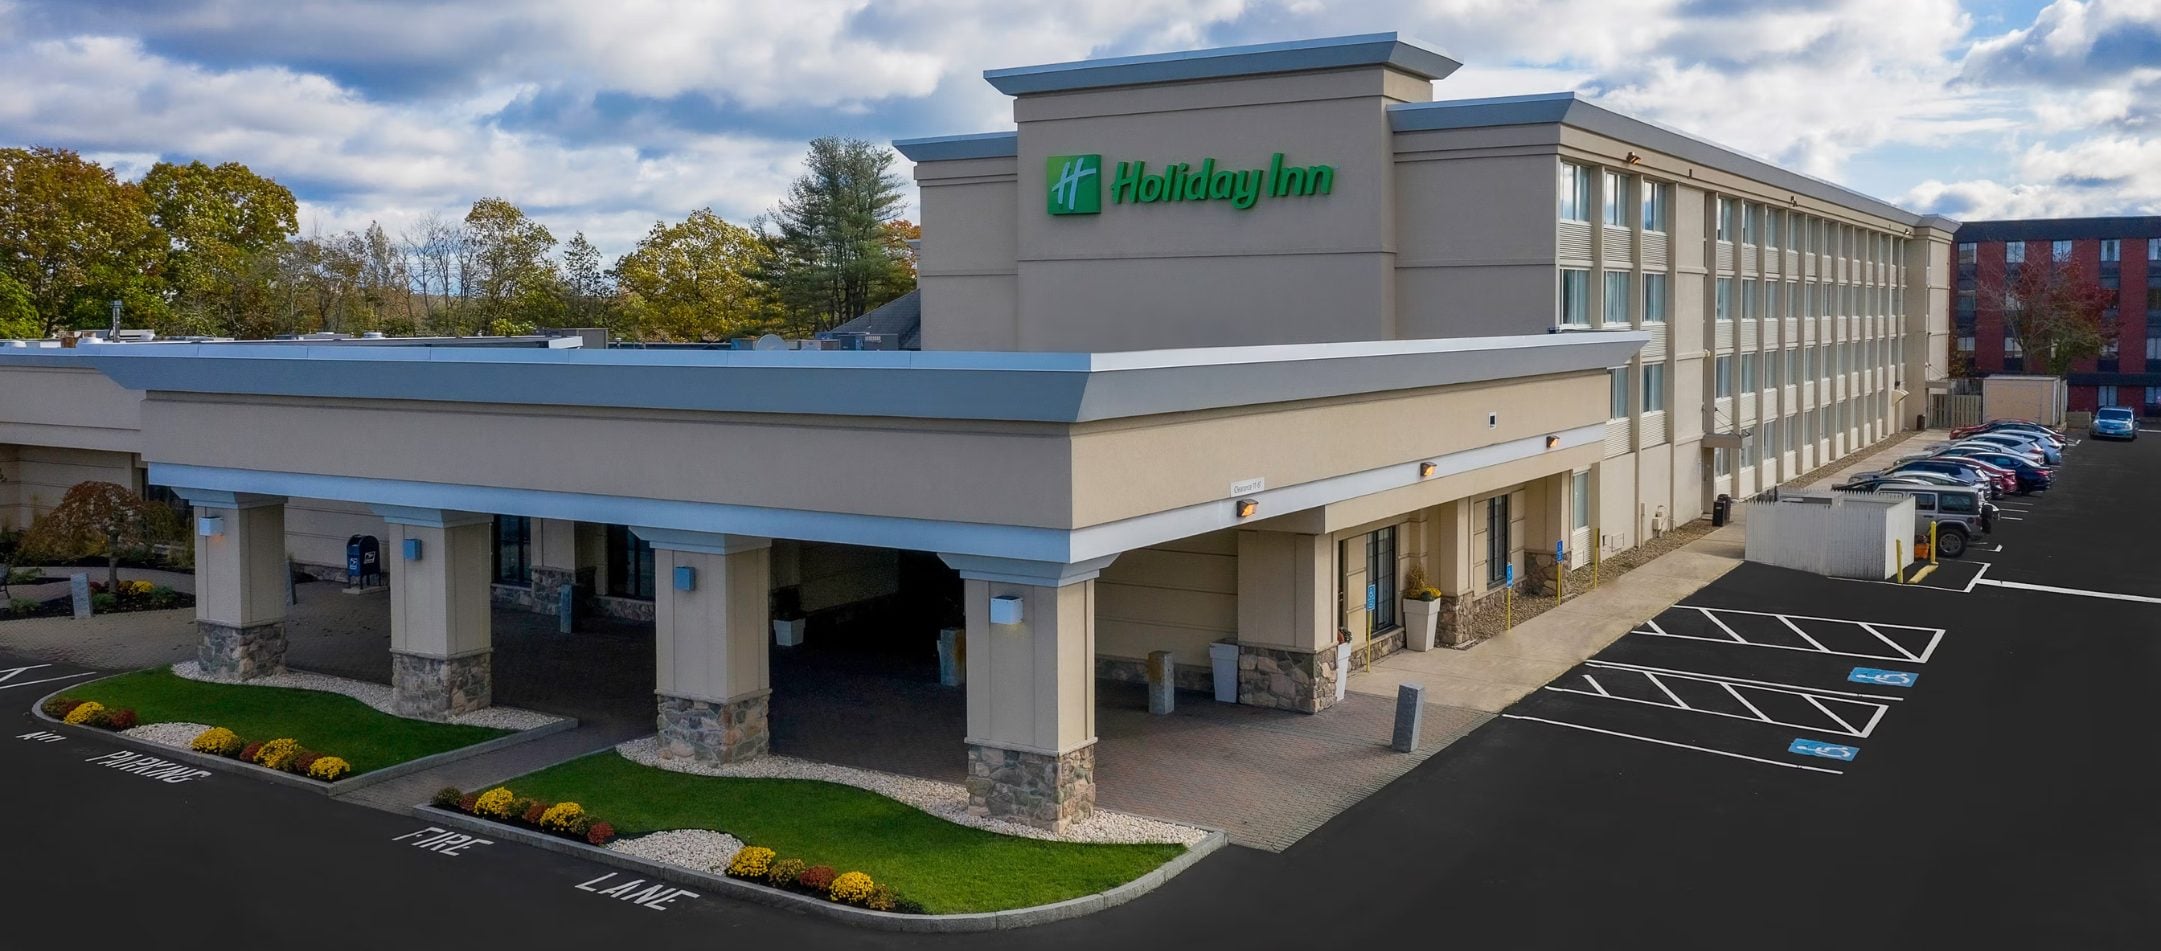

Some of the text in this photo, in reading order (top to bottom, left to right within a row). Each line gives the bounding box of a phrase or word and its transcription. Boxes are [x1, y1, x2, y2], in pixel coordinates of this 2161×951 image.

[1111, 152, 1334, 209] Holiday Inn
[85, 750, 212, 783] PARKING
[392, 826, 700, 911] FIRE LANE
